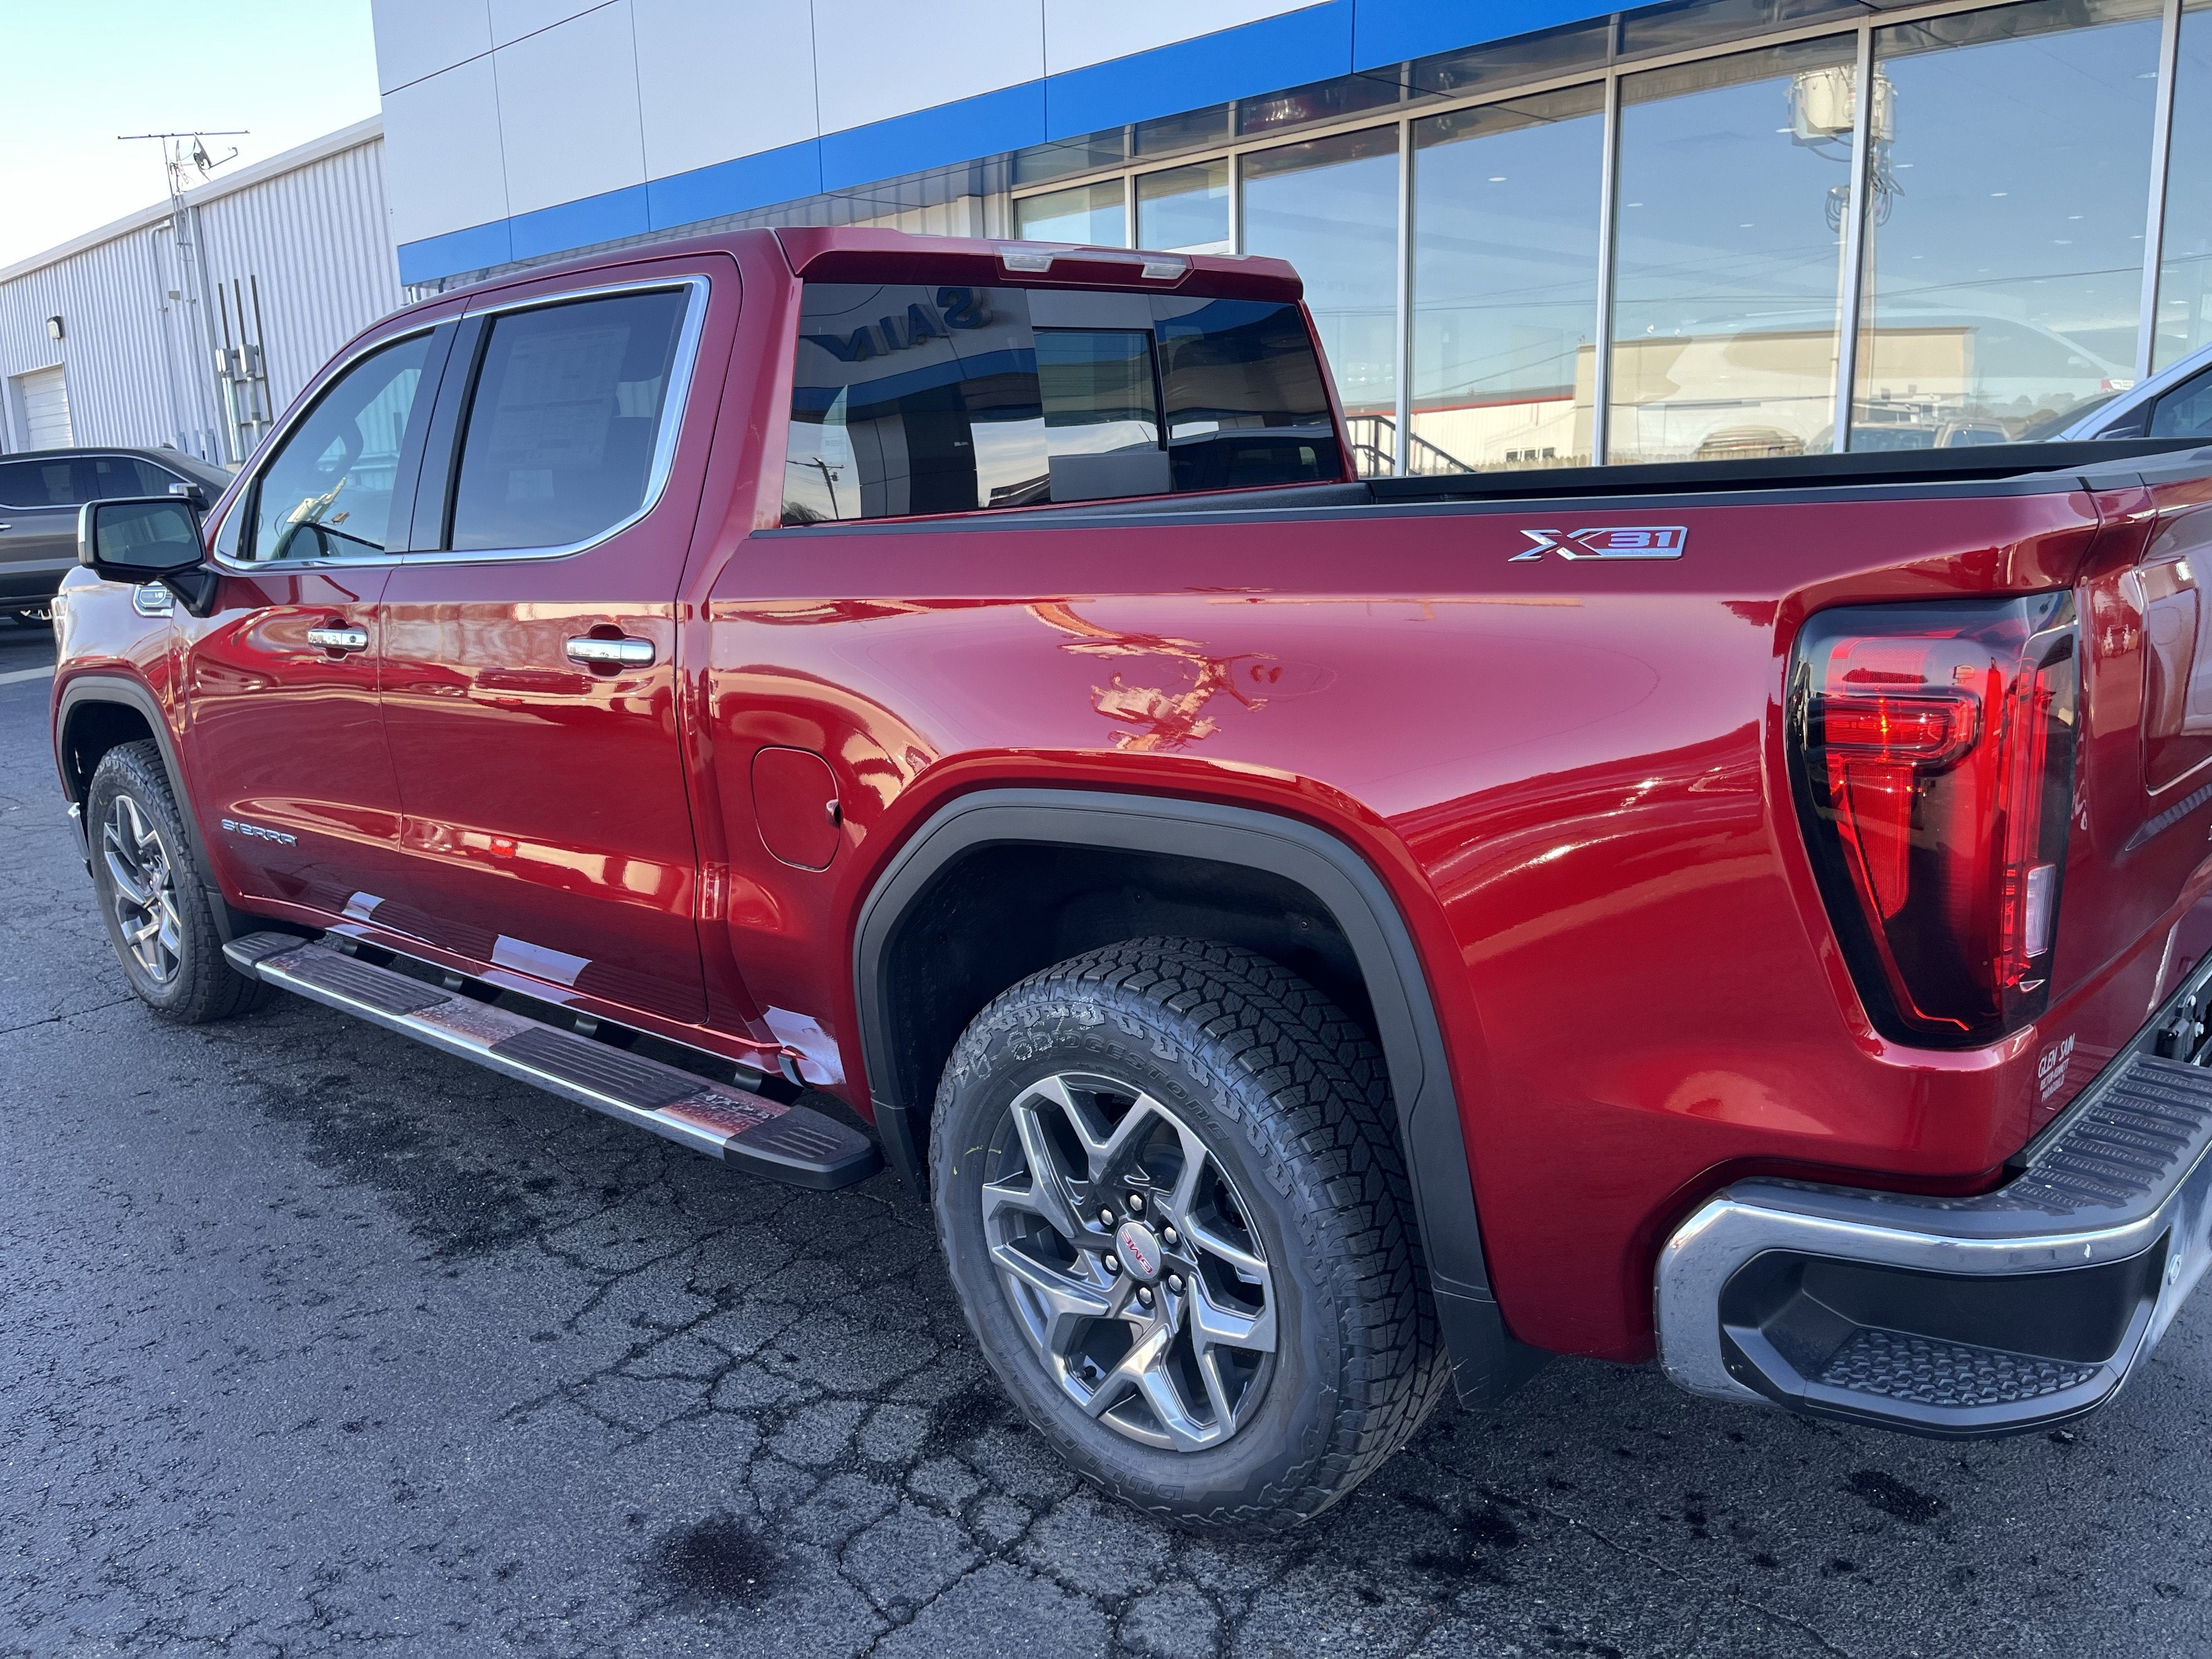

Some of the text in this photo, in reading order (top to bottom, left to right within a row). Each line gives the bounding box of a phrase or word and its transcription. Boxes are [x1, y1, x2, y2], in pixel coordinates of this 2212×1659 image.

[1508, 526, 1688, 561] X31
[221, 819, 298, 848] SIERRA
[2038, 1046, 2058, 1079] GLEN
[1121, 1228, 1153, 1274] GMC
